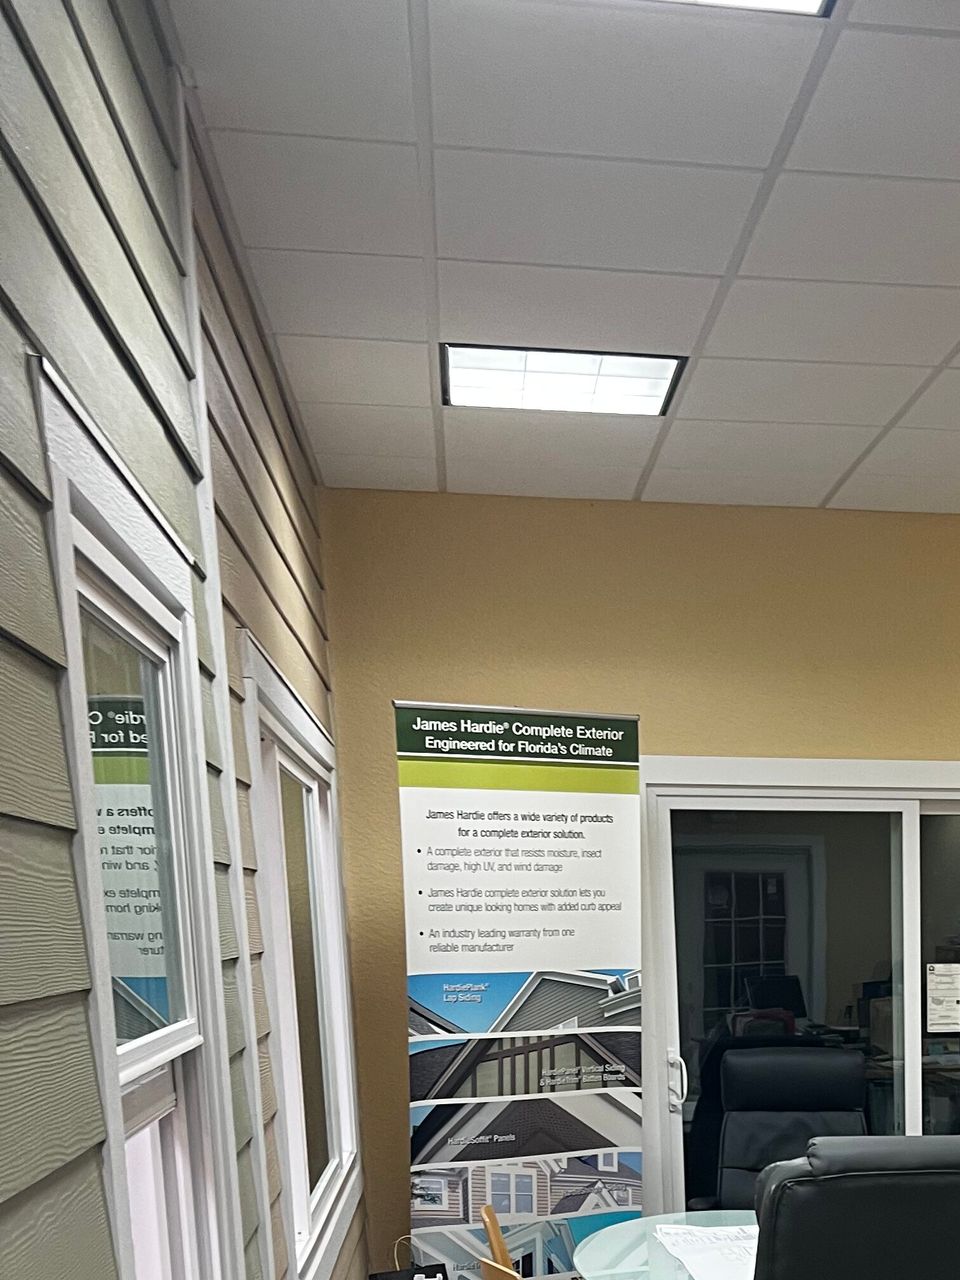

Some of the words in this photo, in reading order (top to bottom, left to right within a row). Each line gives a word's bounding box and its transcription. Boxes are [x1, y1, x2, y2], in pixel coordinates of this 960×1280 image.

[412, 717, 458, 731] James
[511, 722, 573, 739] Complete
[576, 725, 624, 740] Exterior
[425, 736, 495, 752] Engineered
[497, 740, 515, 752] for
[517, 740, 567, 754] Florida's
[569, 743, 613, 757] Climate
[426, 809, 454, 819] James
[457, 810, 485, 820] Hardie
[487, 811, 511, 821] offers
[513, 813, 519, 821] a
[520, 812, 541, 821] wide
[542, 812, 568, 824] variety
[570, 813, 578, 822] of
[579, 814, 614, 824] products
[457, 827, 470, 837] for
[472, 829, 478, 837] a
[480, 829, 518, 839] complete
[520, 829, 551, 838] exterior
[426, 846, 433, 856] A
[434, 847, 472, 858] complete
[473, 848, 503, 857] exterior
[504, 848, 519, 857] that
[521, 848, 545, 857] resists
[581, 849, 602, 858] insect
[464, 862, 481, 873] high
[497, 862, 512, 871] and
[513, 863, 532, 871] wind
[533, 863, 563, 873] damage
[428, 888, 454, 897] James
[456, 888, 482, 897] Hardie
[484, 888, 519, 899] complete
[521, 888, 548, 897] exterior
[550, 888, 577, 897] solution
[579, 888, 591, 897] lets
[592, 889, 606, 899] you
[428, 903, 453, 911] create
[455, 904, 483, 912] unique
[485, 902, 512, 913] looking
[513, 902, 539, 911] homes
[540, 902, 555, 911] with
[557, 902, 579, 911] added
[580, 902, 596, 911] curb
[597, 902, 622, 912] appeal
[428, 929, 440, 938] An
[442, 929, 475, 940] industry
[477, 929, 506, 939] leading
[508, 929, 541, 939] warranty
[542, 928, 560, 936] from
[429, 943, 459, 952] reliable
[461, 943, 514, 952] manufacturer
[443, 993, 457, 1003] Lap
[458, 993, 482, 1003] Siding
[604, 1064, 626, 1073] Siding
